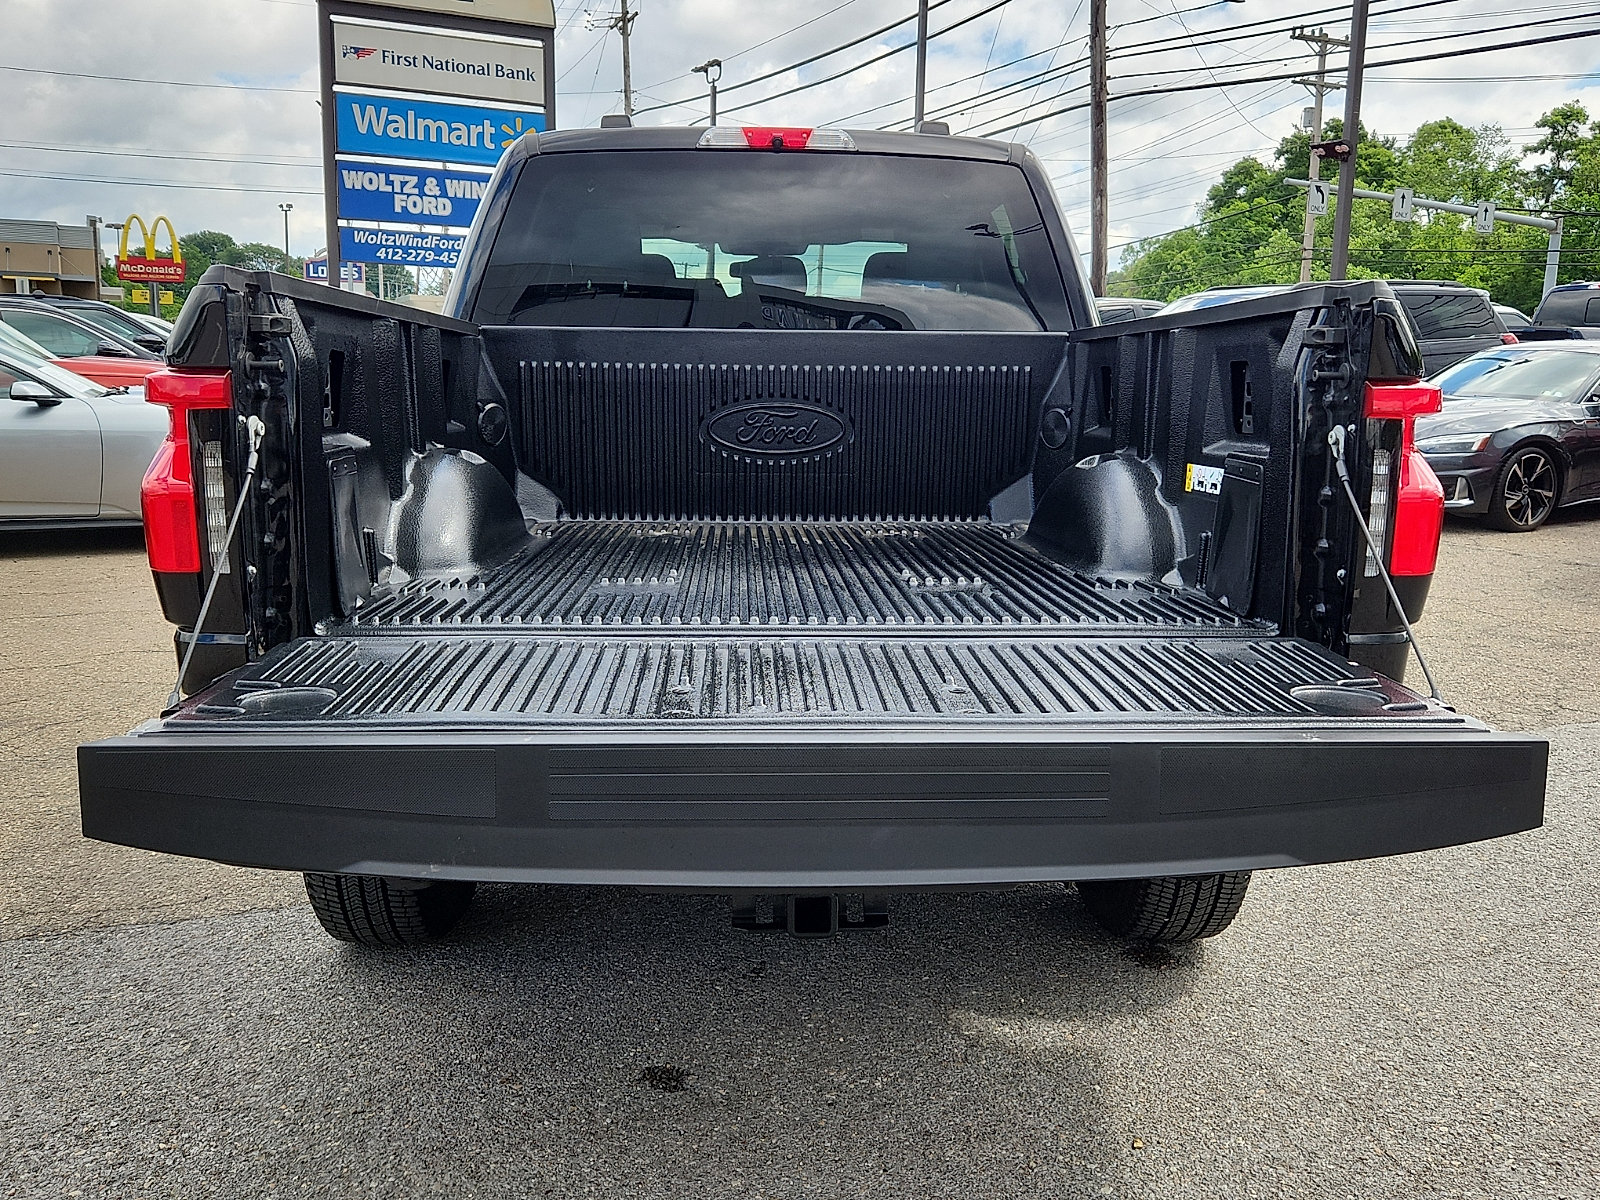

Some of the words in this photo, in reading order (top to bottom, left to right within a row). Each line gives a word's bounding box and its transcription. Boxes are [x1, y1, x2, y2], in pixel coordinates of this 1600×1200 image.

[381, 49, 418, 68] First
[422, 55, 490, 77] National
[495, 64, 536, 82] Bank
[351, 103, 496, 149] Walmart
[341, 169, 419, 195] WOLTZ
[423, 177, 441, 196] &
[444, 178, 489, 200] WIN
[394, 193, 453, 217] FORD
[1311, 204, 1325, 213] ONLY
[1394, 211, 1409, 219] ONLY
[353, 230, 464, 250] WoltzWindFord
[119, 263, 183, 275] McDonald's
[309, 263, 359, 279] LOES
[736, 409, 819, 445] Ford
